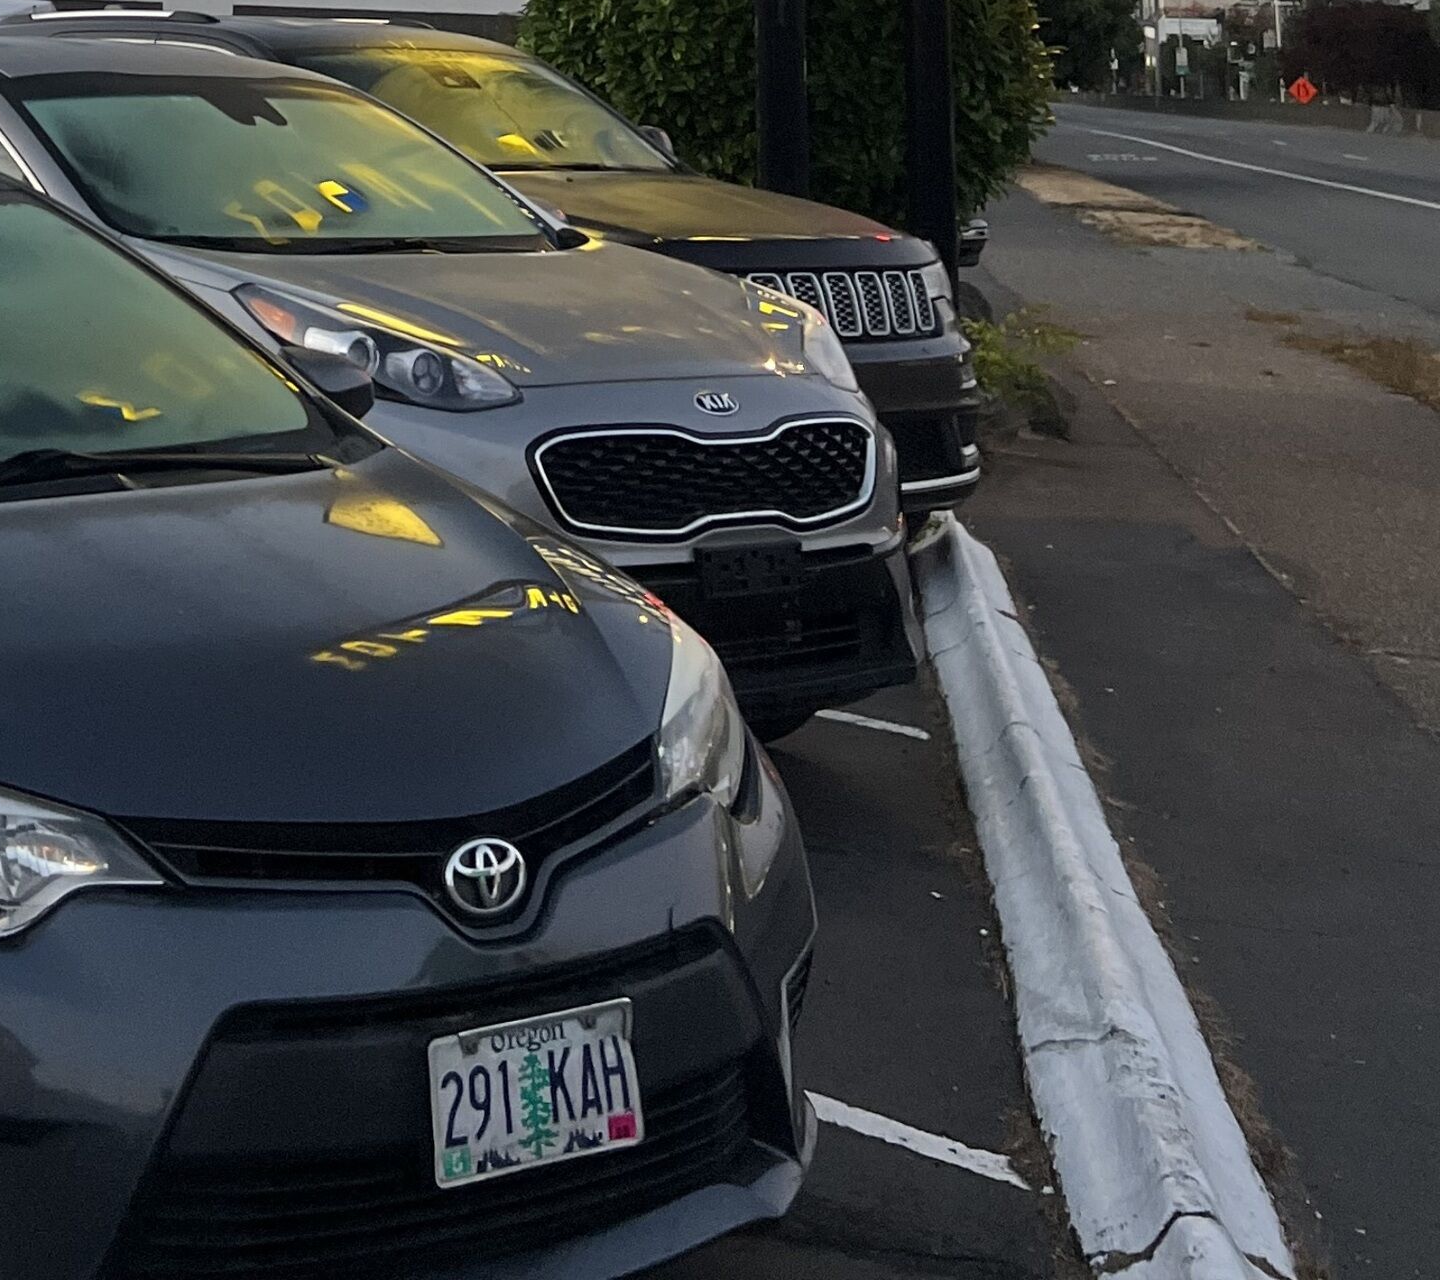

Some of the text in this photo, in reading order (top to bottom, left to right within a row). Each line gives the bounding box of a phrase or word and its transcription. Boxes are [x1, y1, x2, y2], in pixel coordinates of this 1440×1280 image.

[697, 392, 736, 410] KIA
[490, 1021, 566, 1053] Oregon
[441, 1034, 631, 1149] 291 KAH
